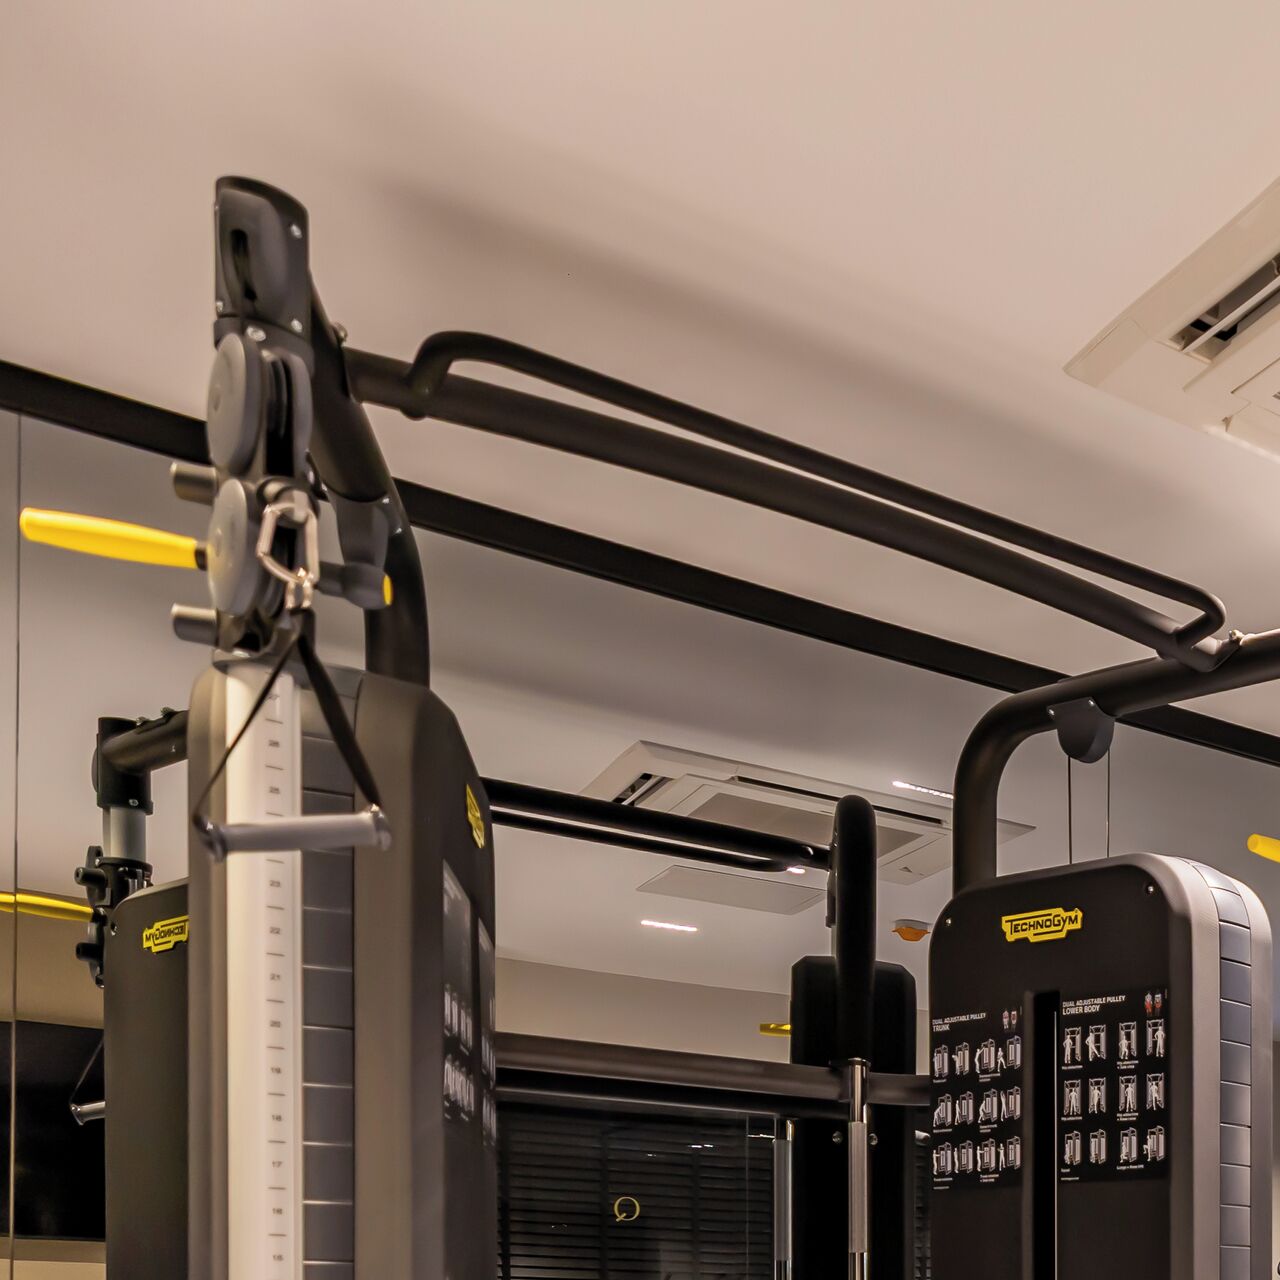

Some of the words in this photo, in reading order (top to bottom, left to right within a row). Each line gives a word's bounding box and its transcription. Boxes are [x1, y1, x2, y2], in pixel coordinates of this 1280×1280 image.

[1005, 913, 1079, 936] TECHNOGYM
[1107, 995, 1126, 1003] PULLEY
[1062, 1006, 1083, 1015] LOWER
[1084, 1004, 1100, 1013] BODY
